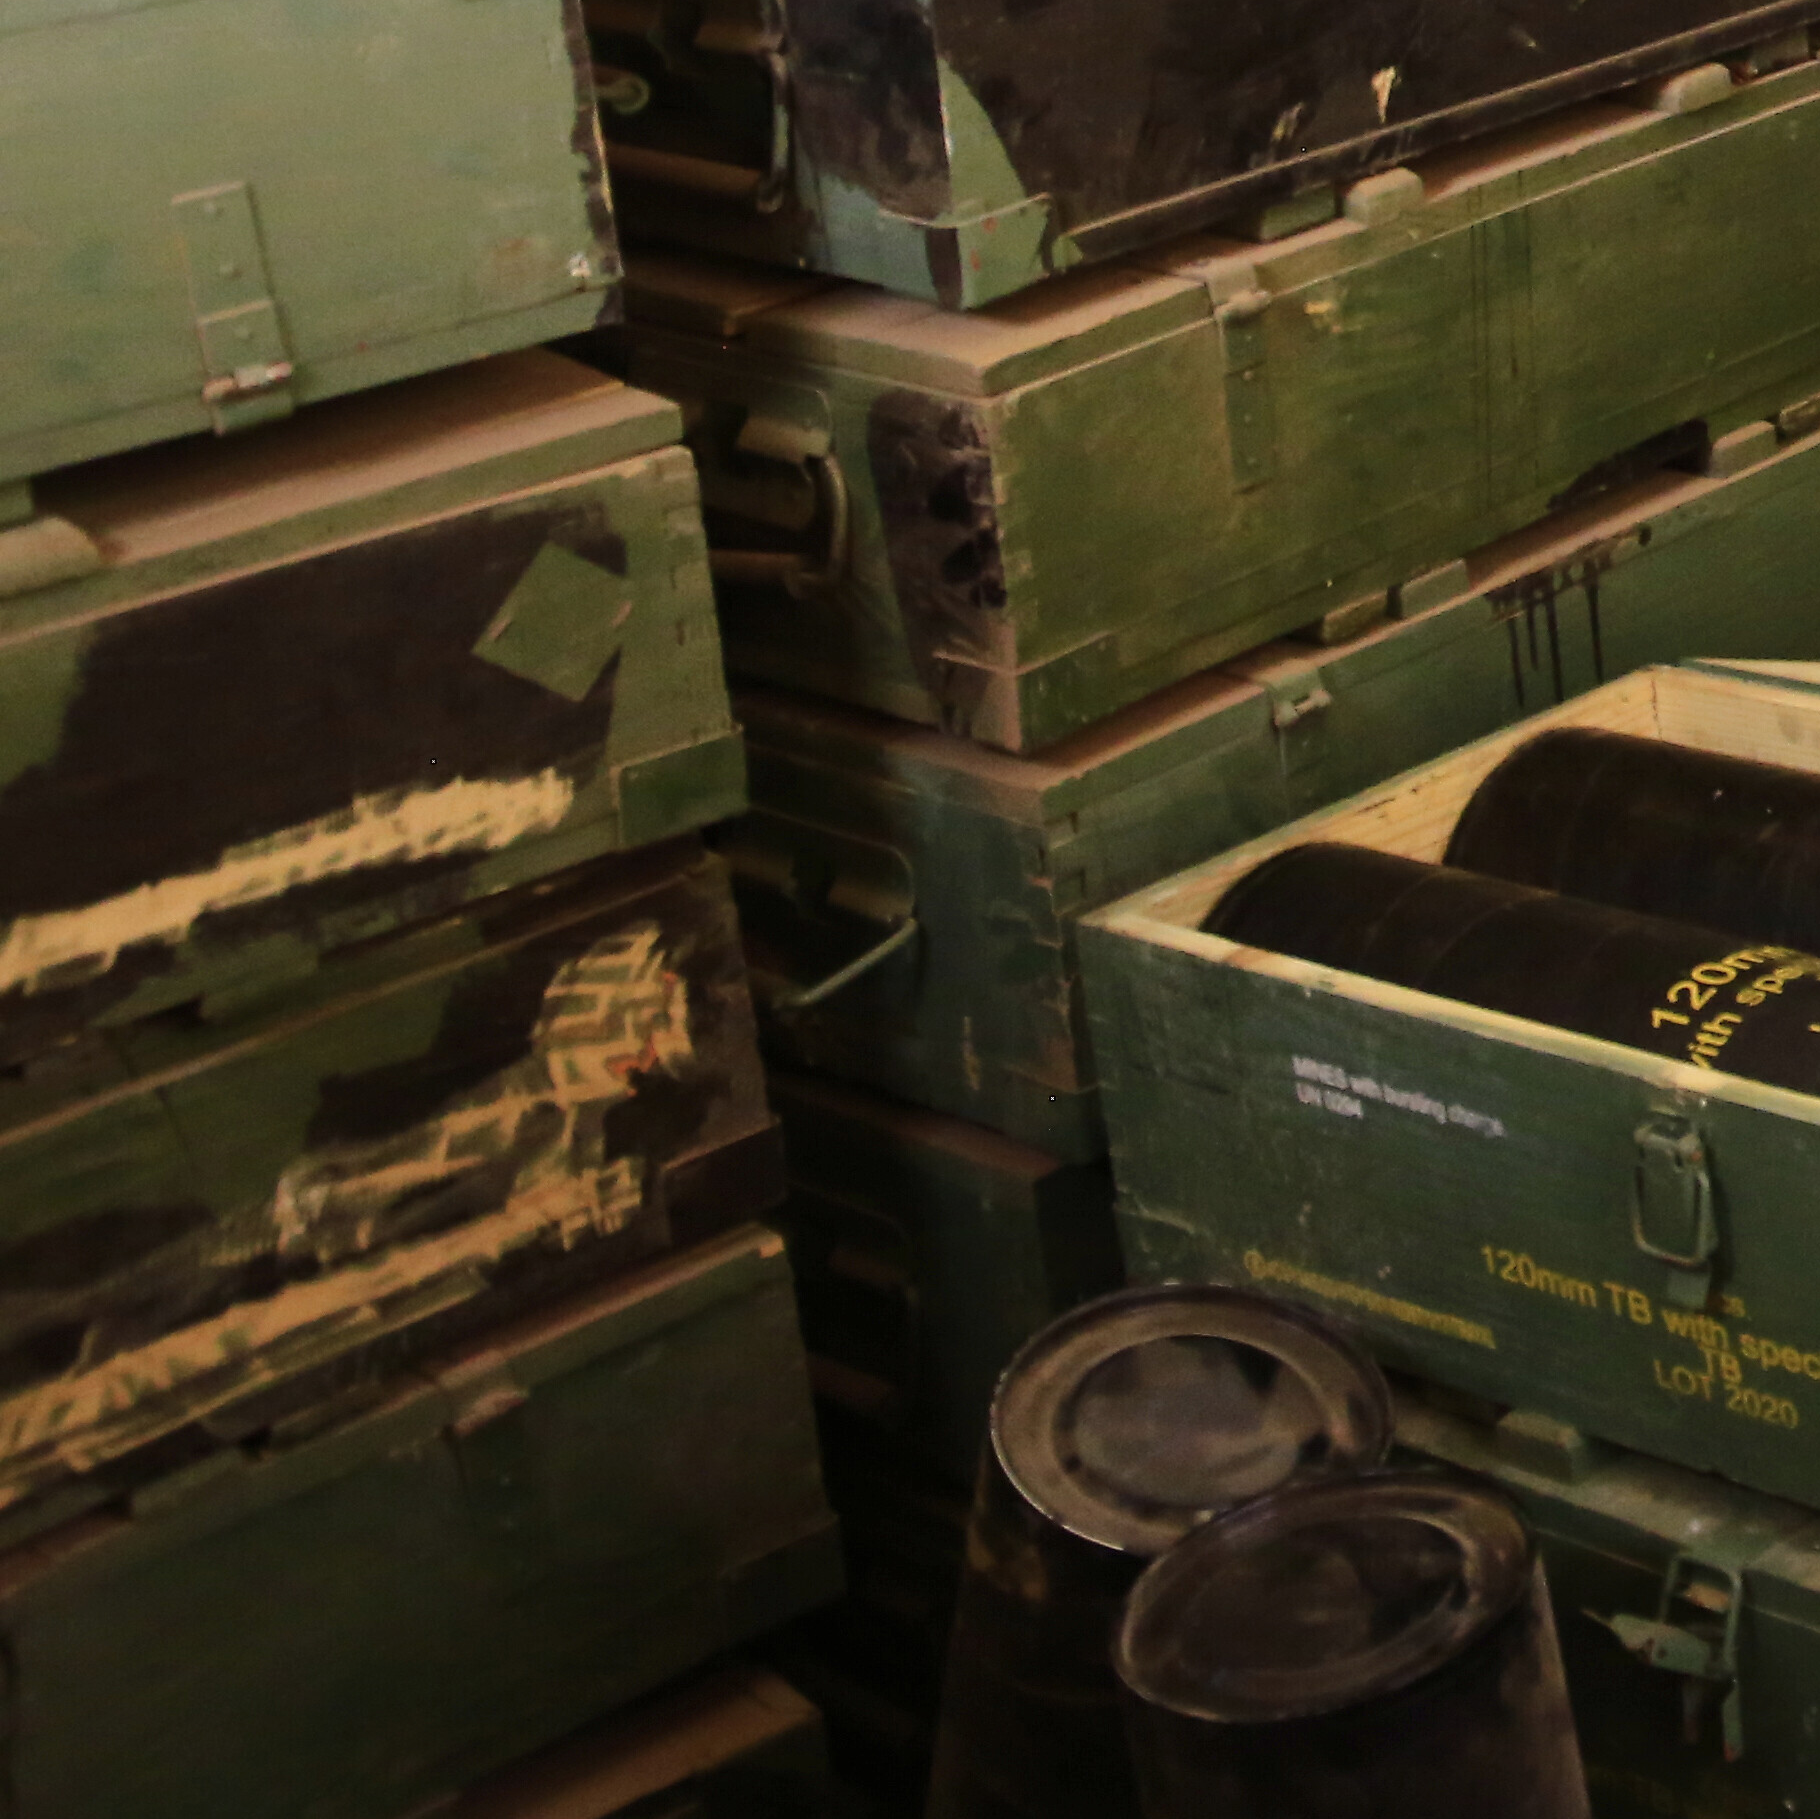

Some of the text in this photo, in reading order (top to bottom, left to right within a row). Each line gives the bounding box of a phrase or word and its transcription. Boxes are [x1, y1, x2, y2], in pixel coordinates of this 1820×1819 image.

[1481, 1244, 1598, 1309] 120mm
[1602, 1281, 1653, 1326] TB
[1661, 1309, 1730, 1353] with
[1653, 1360, 1800, 1430] LOT 2020
